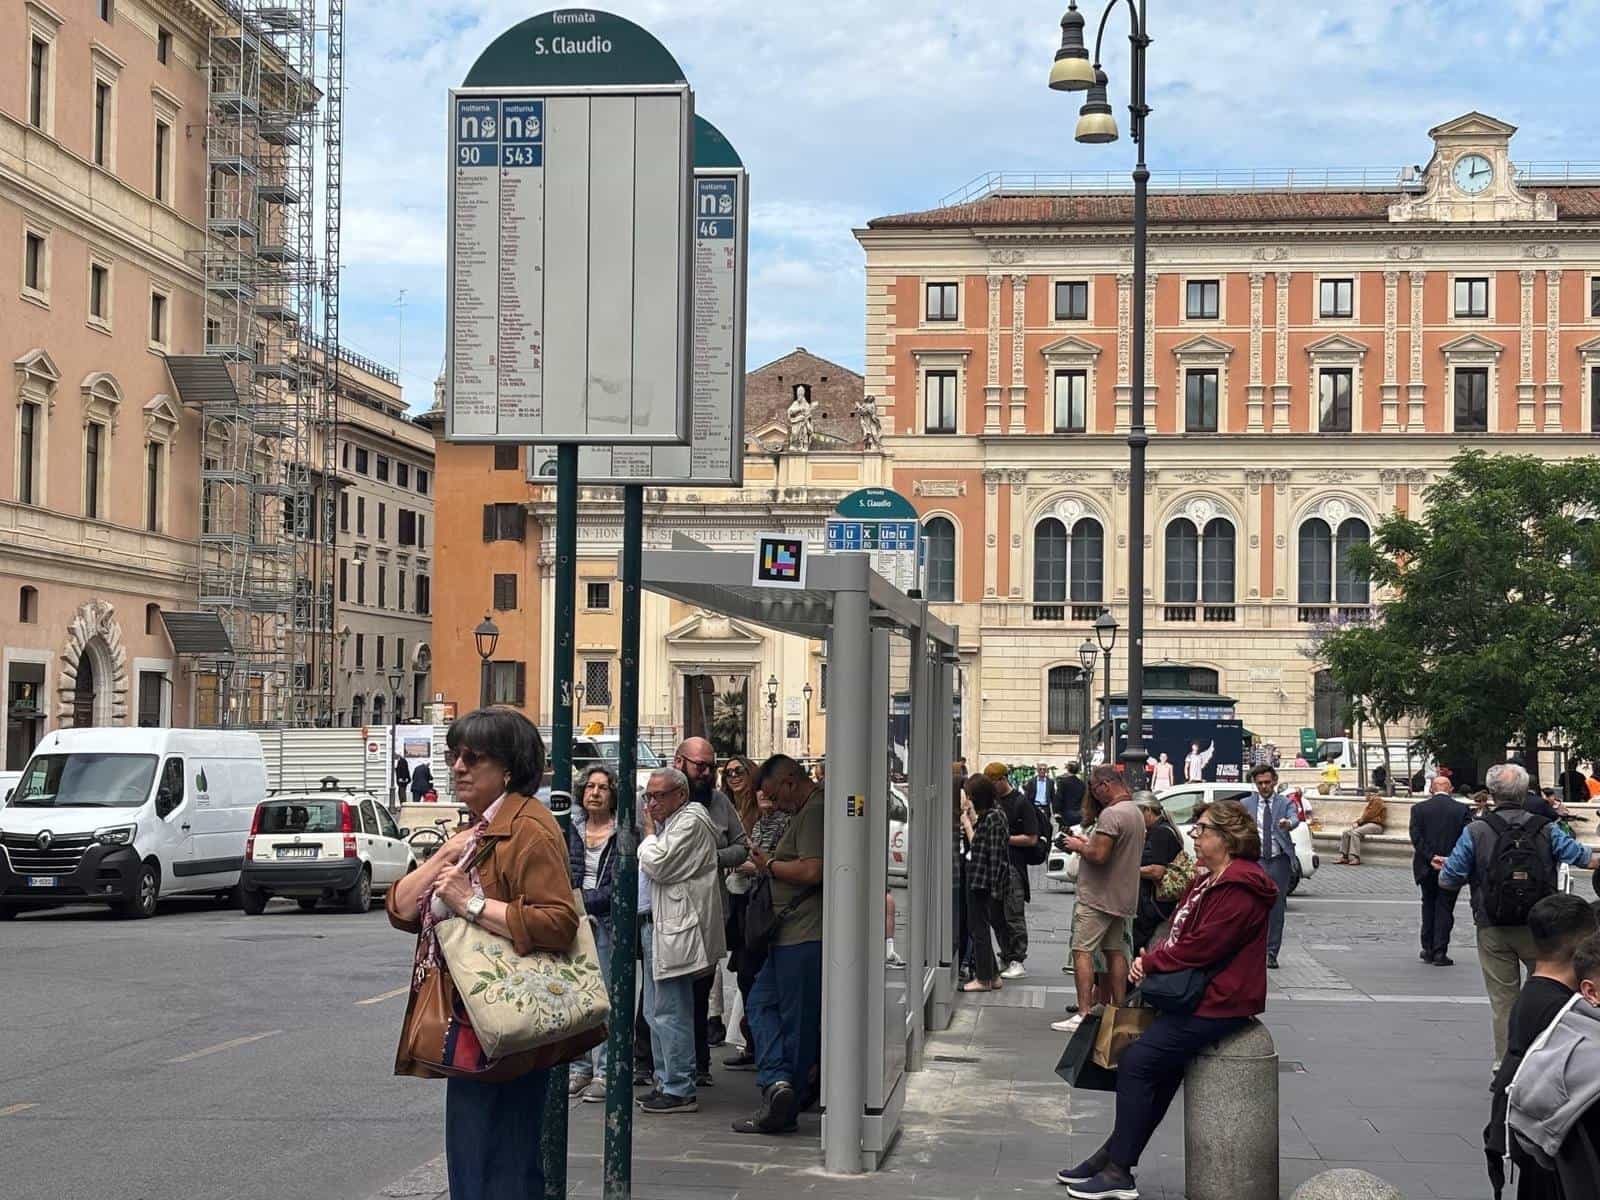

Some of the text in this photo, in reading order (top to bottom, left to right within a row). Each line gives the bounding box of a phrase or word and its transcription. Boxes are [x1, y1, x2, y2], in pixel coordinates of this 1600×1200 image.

[552, 12, 596, 25] fermata
[535, 36, 612, 55] S. Claudio
[461, 104, 490, 112] notturna
[460, 146, 480, 164] 90
[505, 147, 533, 165] 543
[700, 221, 718, 237] 46
[867, 499, 892, 508] Claudio
